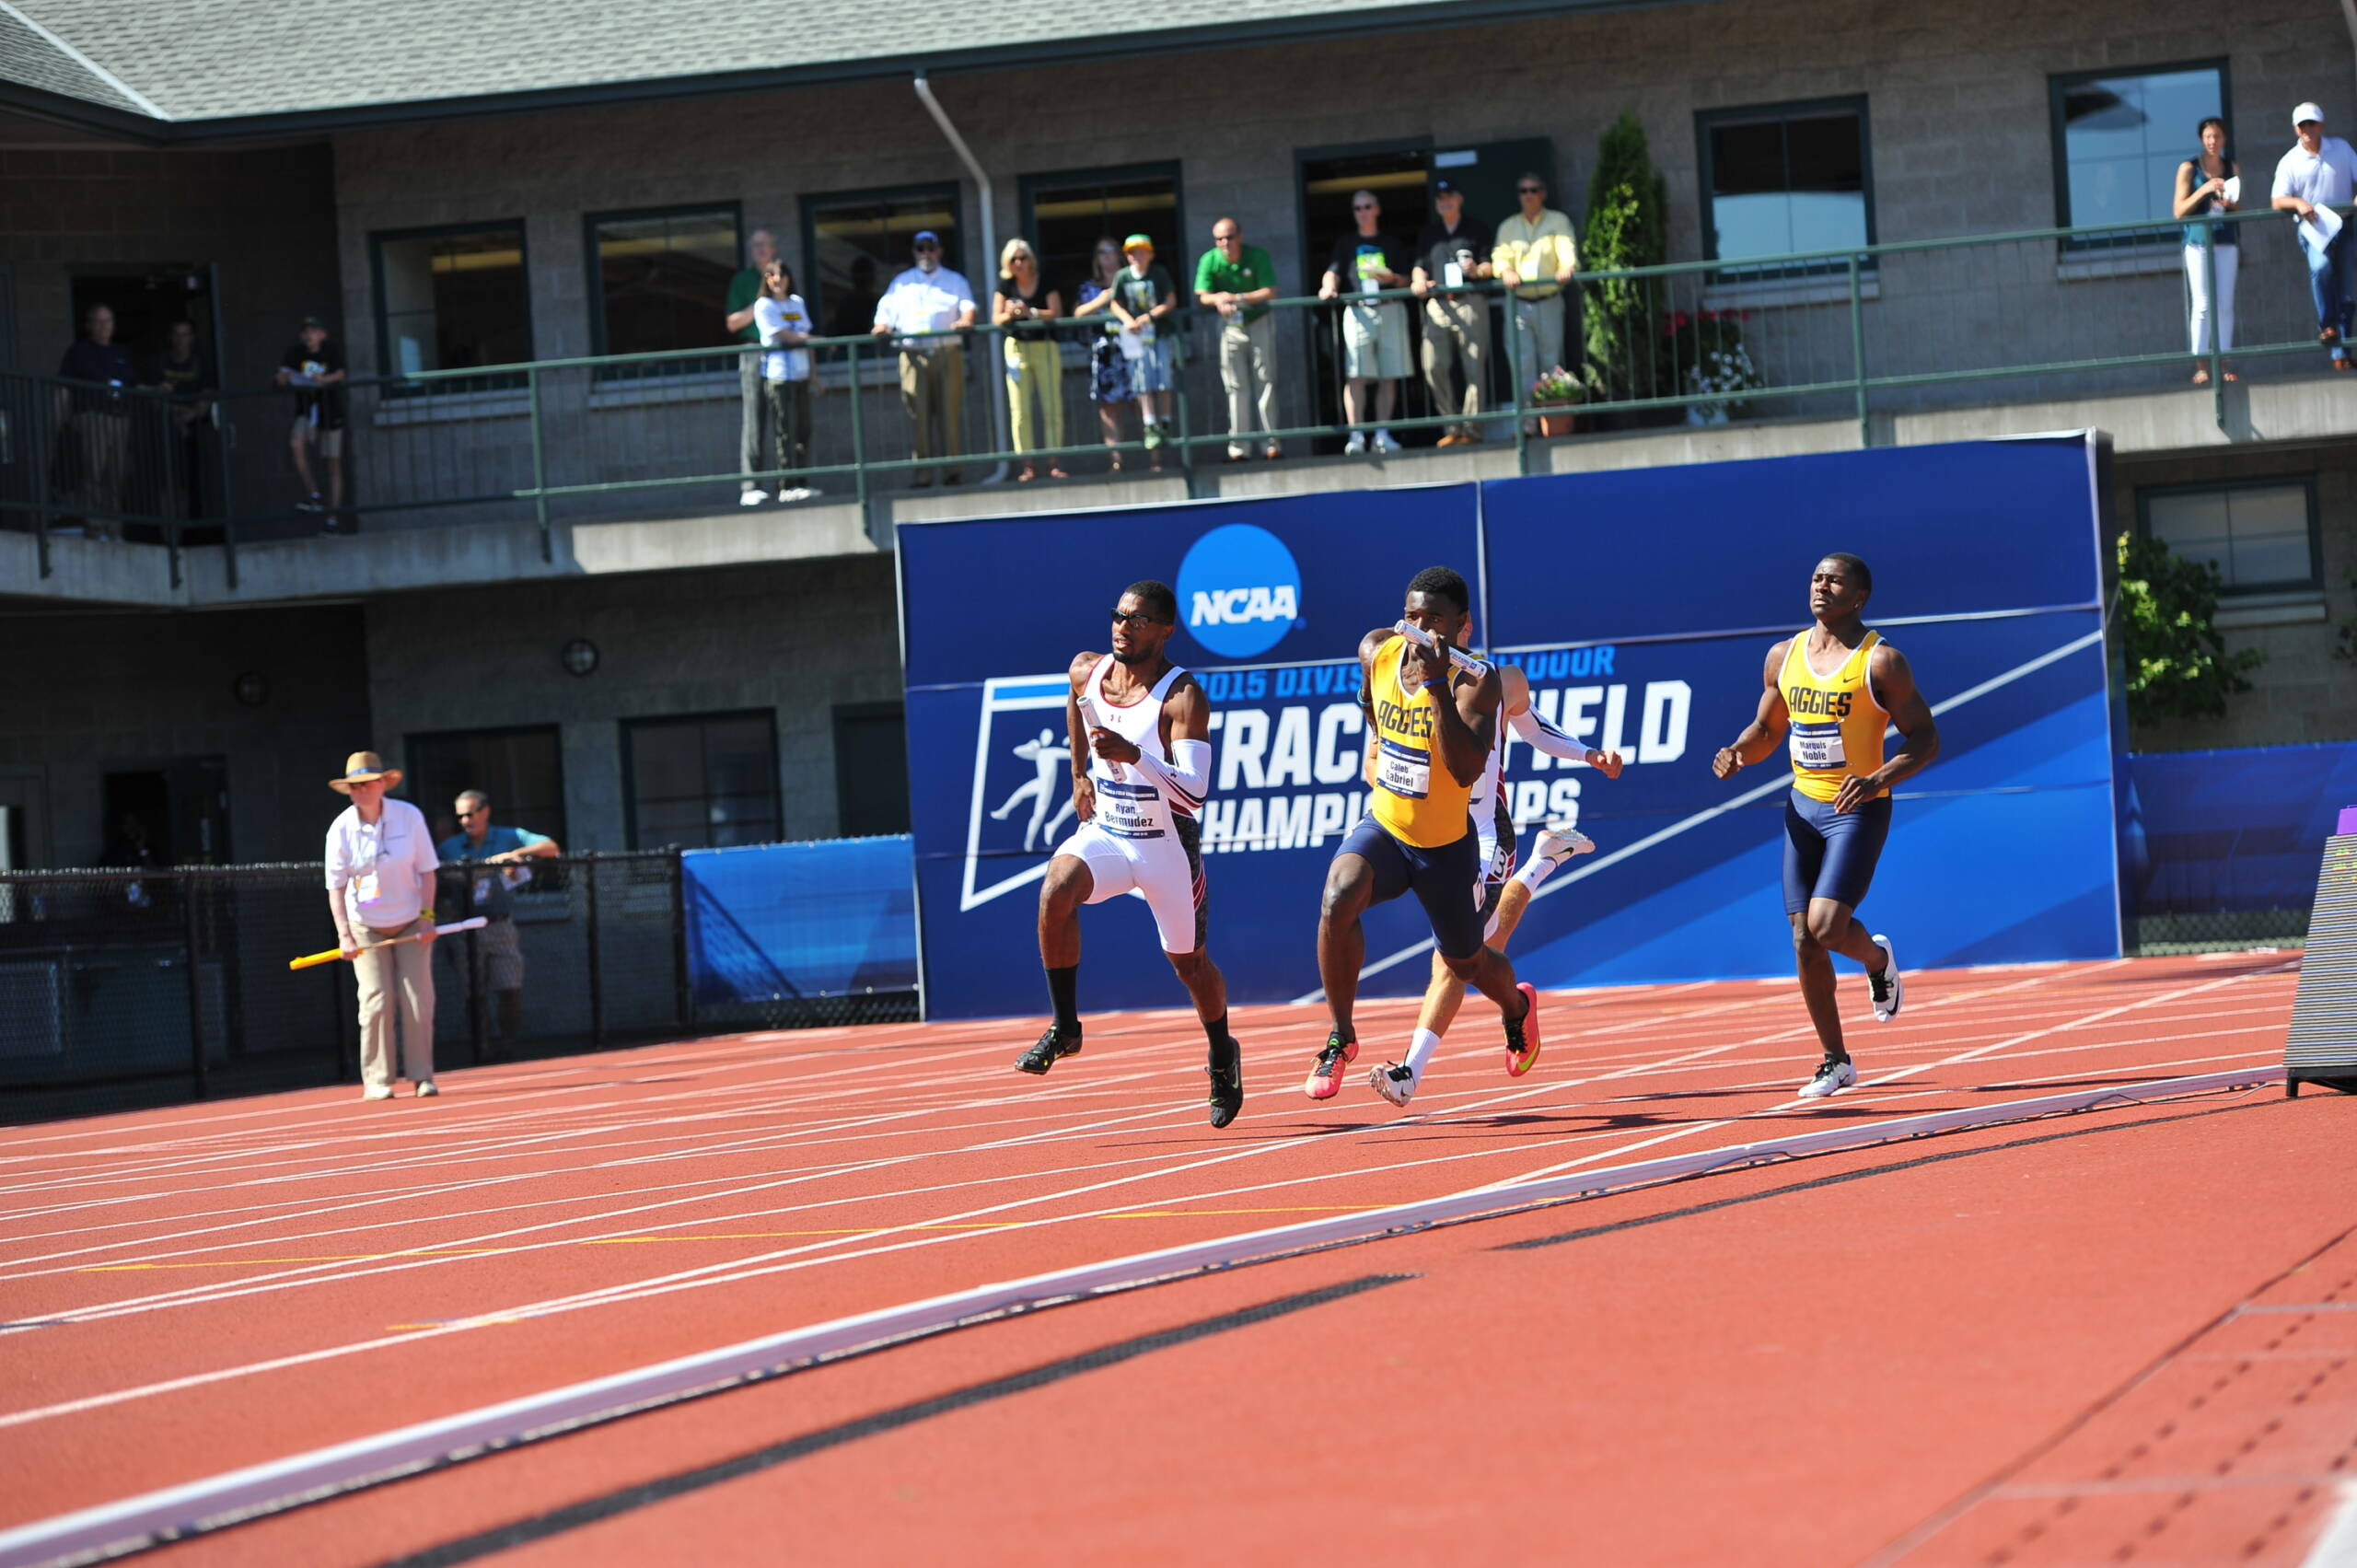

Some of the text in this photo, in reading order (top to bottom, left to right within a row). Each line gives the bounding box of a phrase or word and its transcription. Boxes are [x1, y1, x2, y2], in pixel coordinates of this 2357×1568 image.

[1190, 585, 1297, 626] NCAA
[1789, 687, 1852, 716] AGGIES
[1378, 700, 1432, 738] AGGES
[1800, 741, 1827, 750] Marquis
[1803, 751, 1827, 760] Noble
[1390, 761, 1409, 772] Caleb
[1386, 770, 1413, 787] Gabriel
[1115, 803, 1135, 815] Ryan
[1105, 811, 1154, 827] Bermudez
